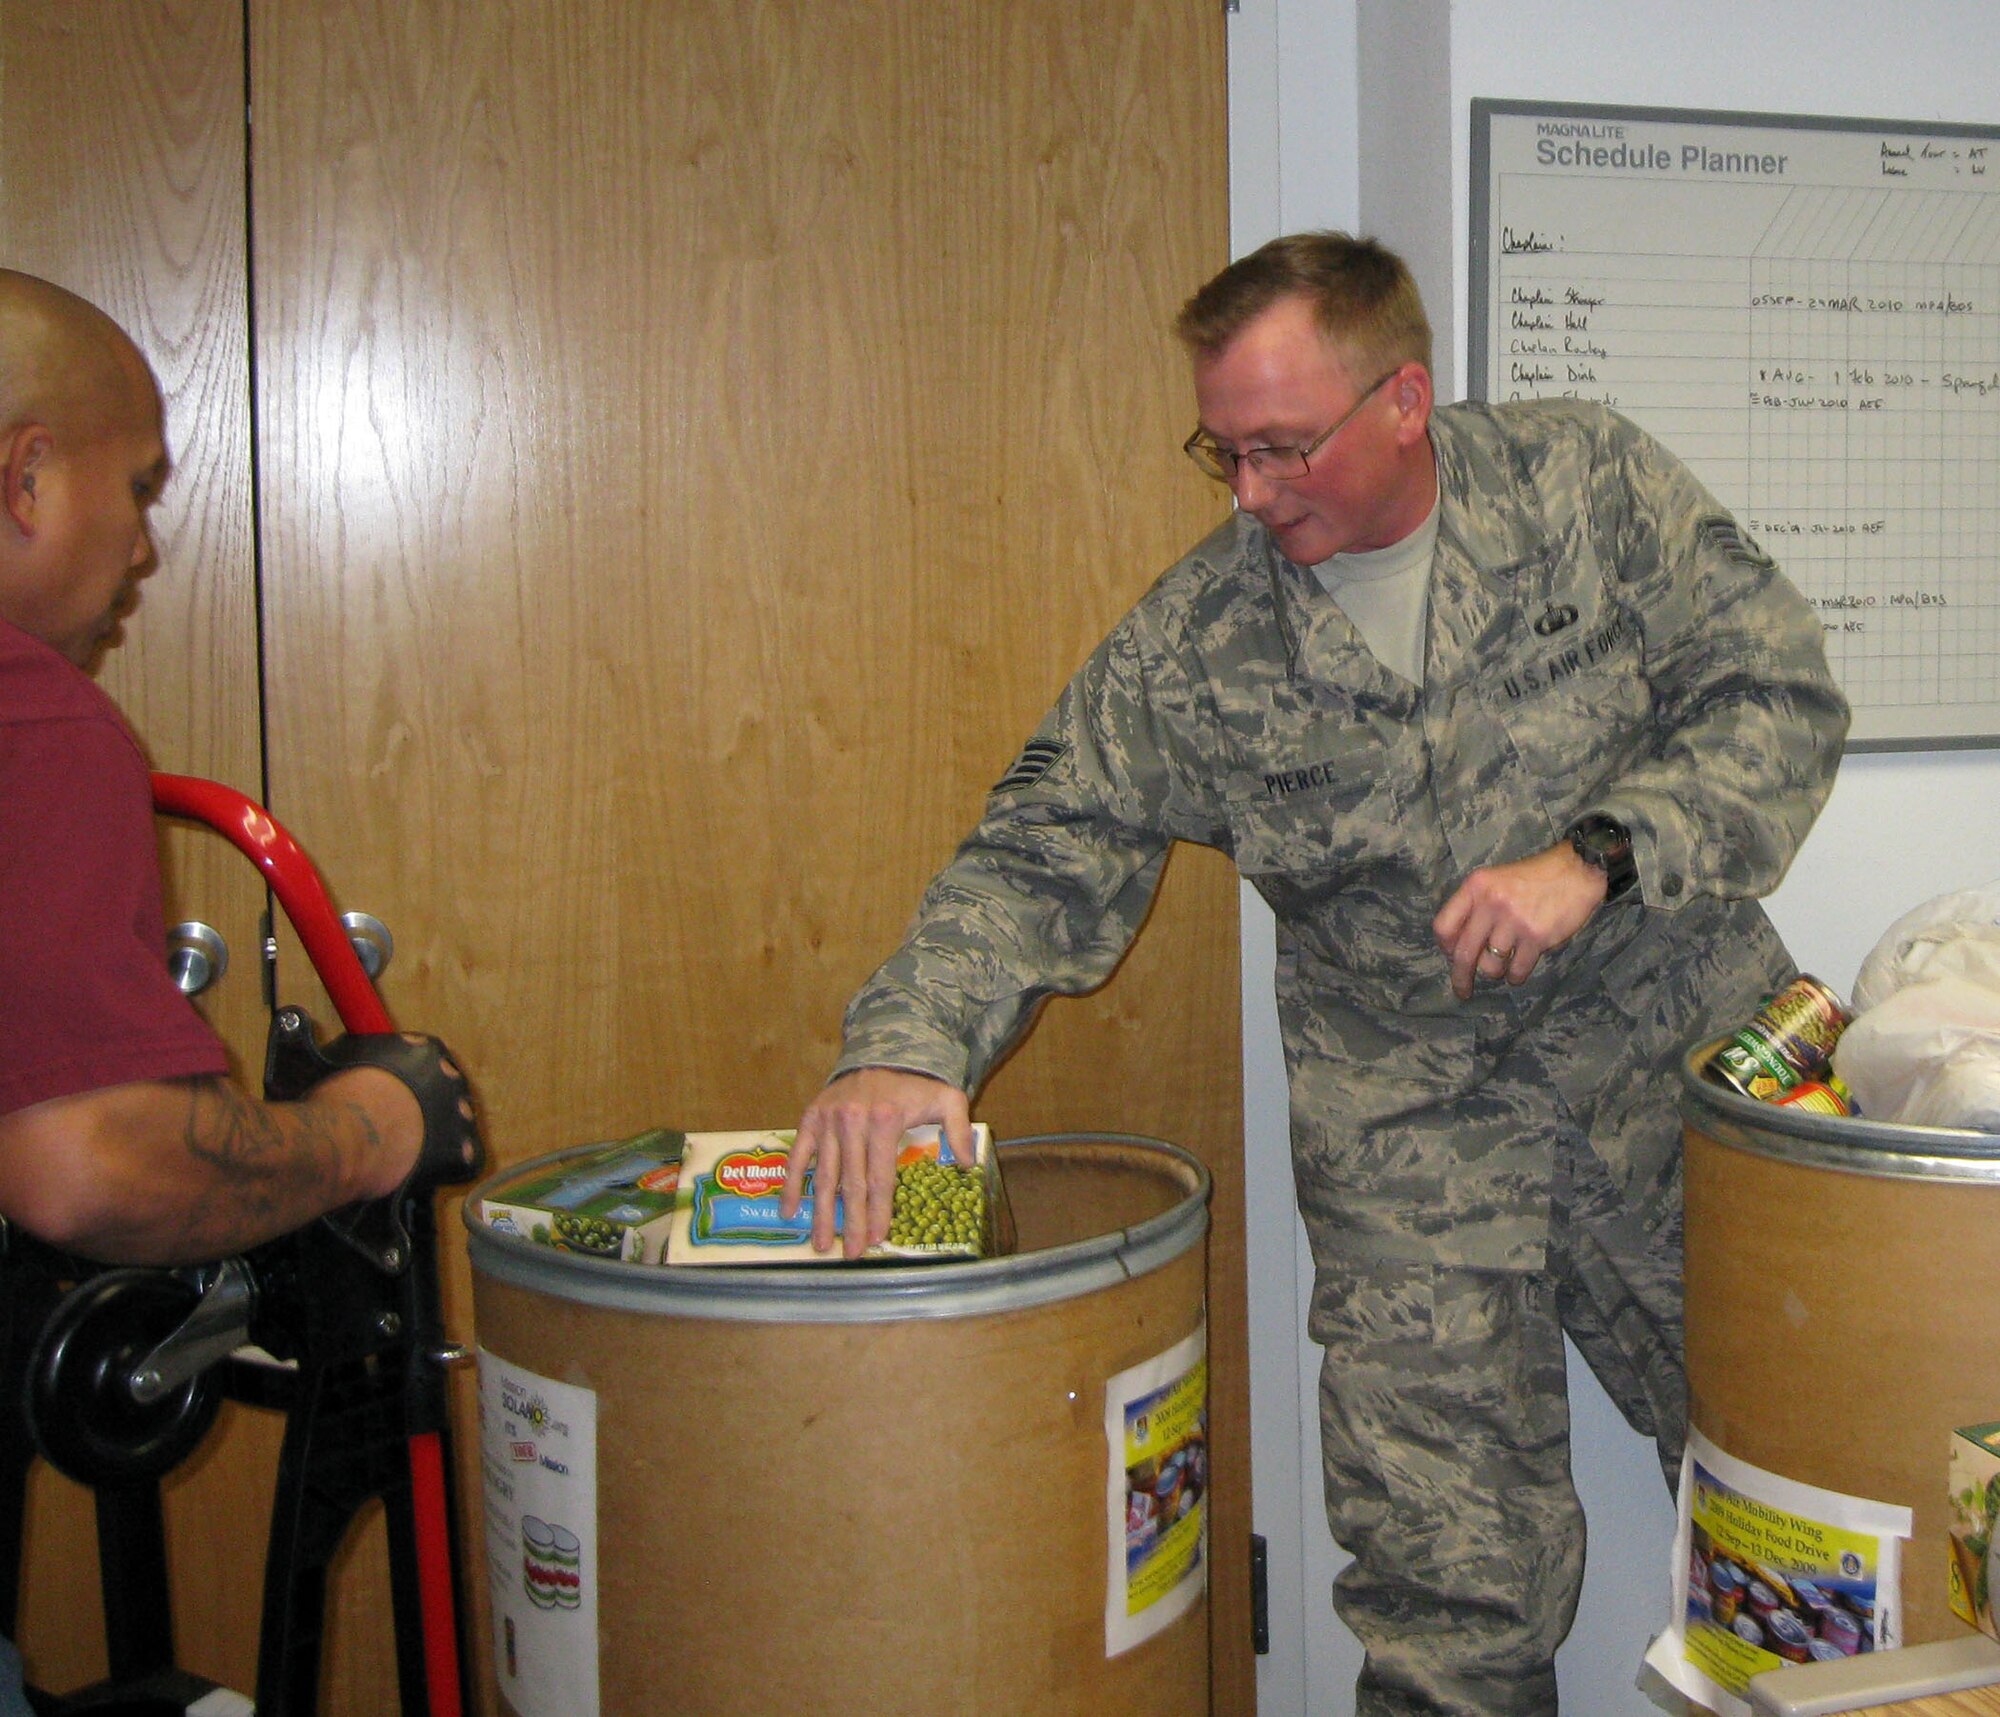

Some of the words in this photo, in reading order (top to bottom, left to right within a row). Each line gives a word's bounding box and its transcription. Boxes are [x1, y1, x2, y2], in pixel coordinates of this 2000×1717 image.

[1537, 123, 1624, 139] MAGNALITE
[1536, 138, 1671, 170] Schedule
[1681, 145, 1788, 176] Planner
[1868, 299, 1903, 311] 2010
[1505, 668, 1548, 700] U.S.
[1549, 649, 1581, 683] AIR
[1585, 614, 1626, 664] FORCE
[1265, 759, 1338, 796] PIERCE
[723, 1165, 745, 1179] Del
[1725, 1508, 1762, 1540] Holiday
[1765, 1527, 1792, 1550] Food
[1795, 1537, 1831, 1561] Drive
[1741, 1498, 1786, 1531] Mobility
[1789, 1517, 1824, 1543] Wing
[1790, 1556, 1818, 1575] 2009
